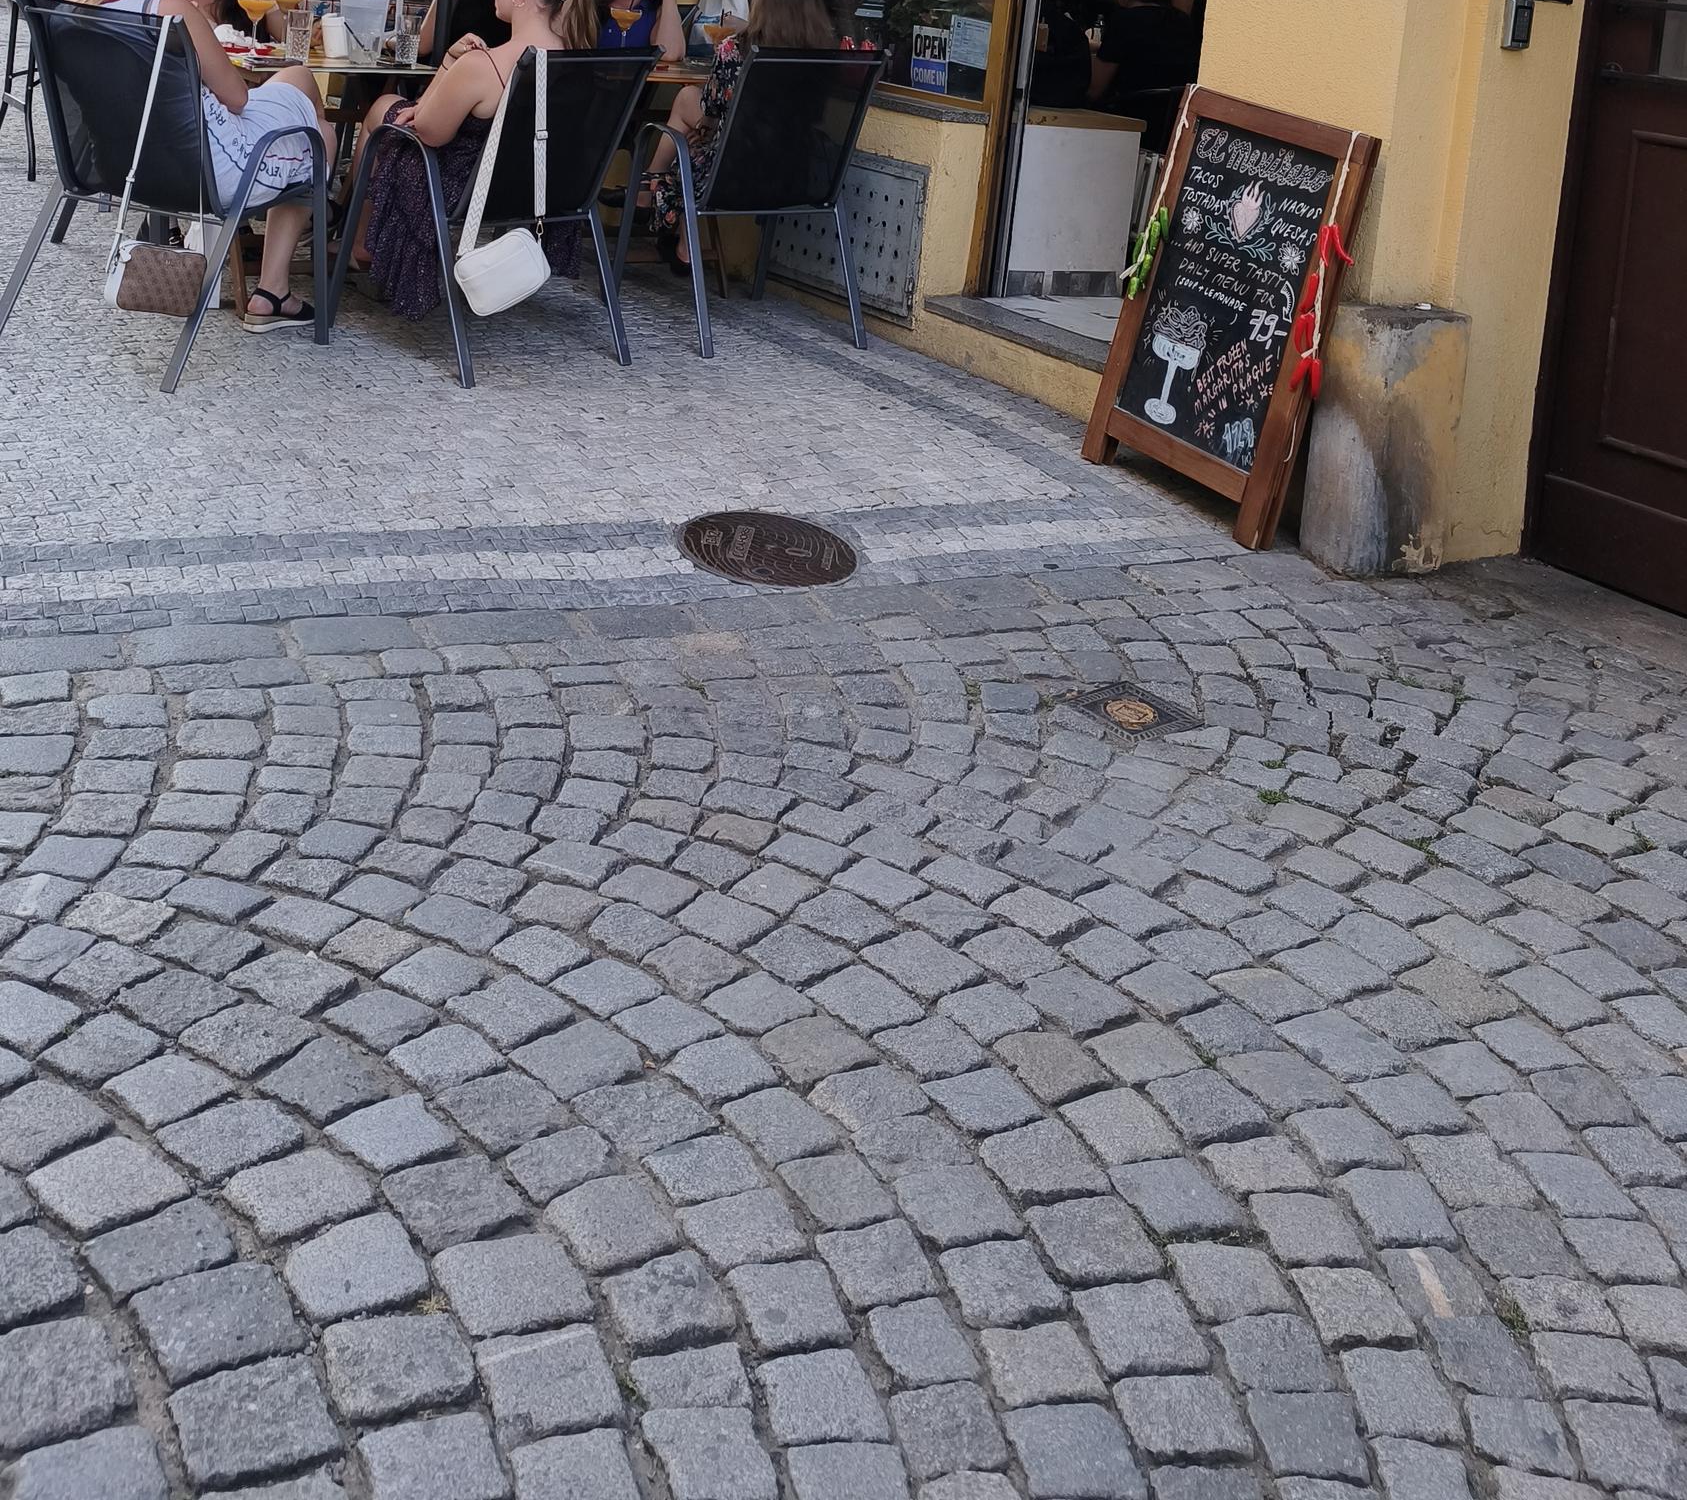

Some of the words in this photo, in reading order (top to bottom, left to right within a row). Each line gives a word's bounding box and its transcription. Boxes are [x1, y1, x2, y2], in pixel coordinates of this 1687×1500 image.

[914, 33, 947, 61] OPEN
[913, 67, 936, 85] COME
[936, 70, 945, 87] IN
[1196, 128, 1228, 163] El
[1189, 166, 1224, 188] TACOS
[1182, 187, 1226, 215] TOSTADAS
[1278, 198, 1323, 220] NACHOS
[1271, 218, 1317, 247] QUESAS
[1205, 247, 1241, 272] SUPER
[1246, 262, 1286, 288] TASTY
[1179, 258, 1210, 279] DAILY
[1212, 273, 1250, 296] MENU
[1253, 289, 1276, 308] FOR
[1196, 365, 1214, 393] BEST
[1216, 338, 1248, 375] FROZEN
[1194, 353, 1251, 415] MARGARITAS
[1218, 397, 1228, 411] IN
